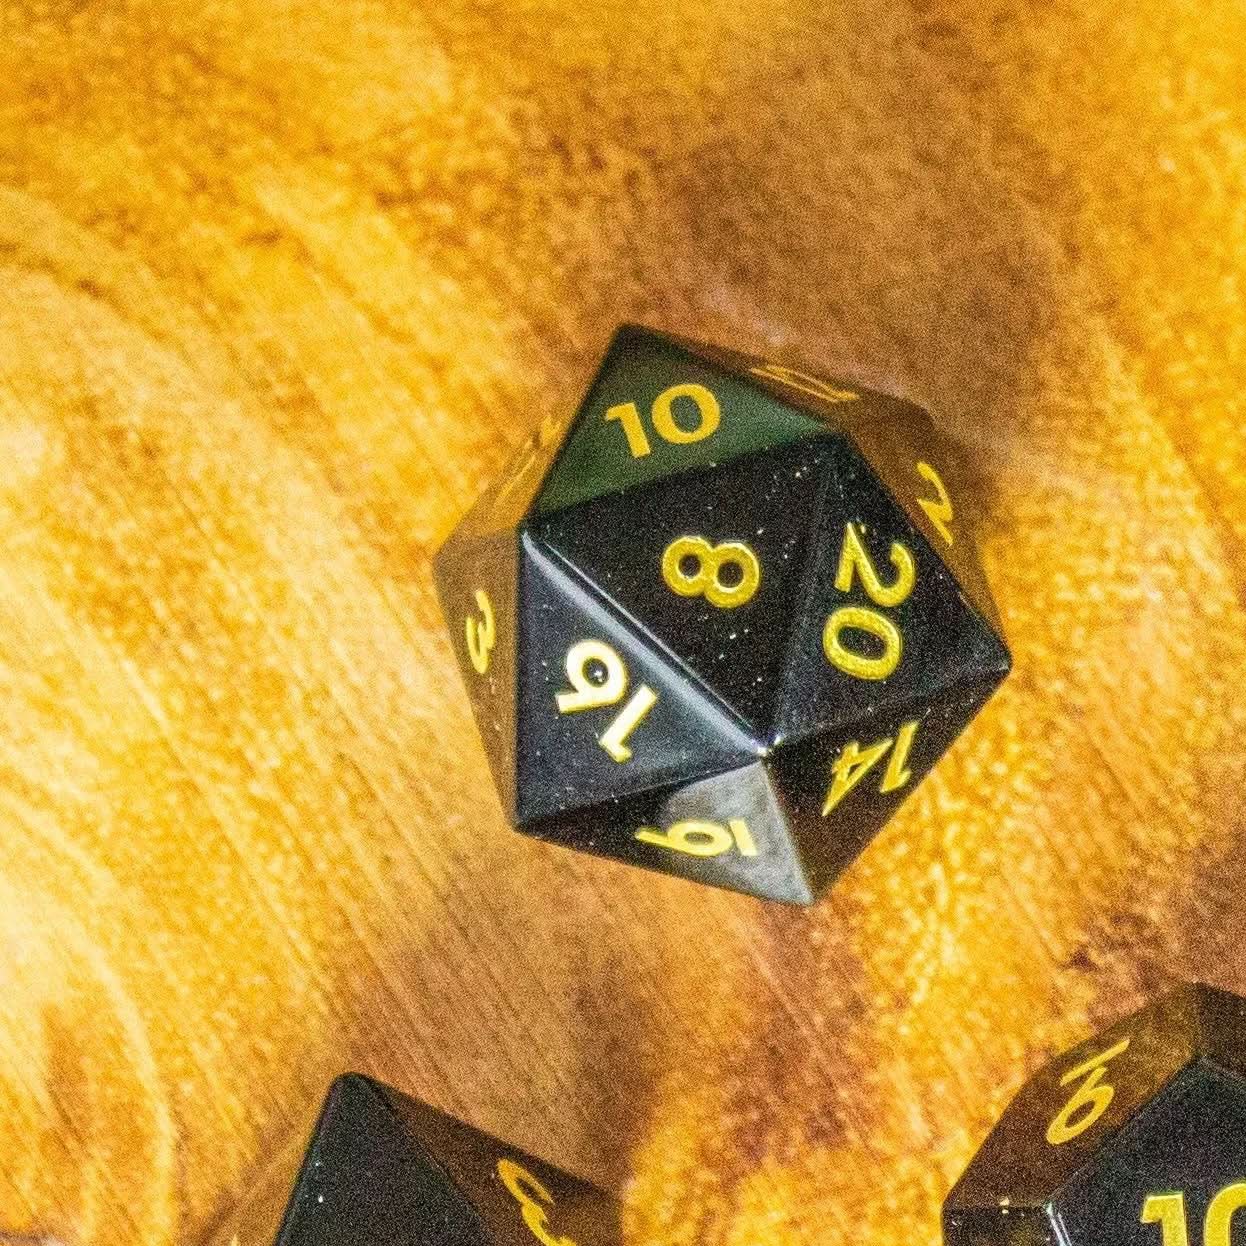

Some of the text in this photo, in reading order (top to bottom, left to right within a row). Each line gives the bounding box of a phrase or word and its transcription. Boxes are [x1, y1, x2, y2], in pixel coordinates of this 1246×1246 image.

[606, 383, 720, 458] 10
[916, 462, 954, 547] 2
[662, 535, 759, 607] 8
[823, 522, 916, 680] 20
[467, 592, 496, 673] 3
[558, 640, 658, 762] 16
[823, 723, 918, 815] 14
